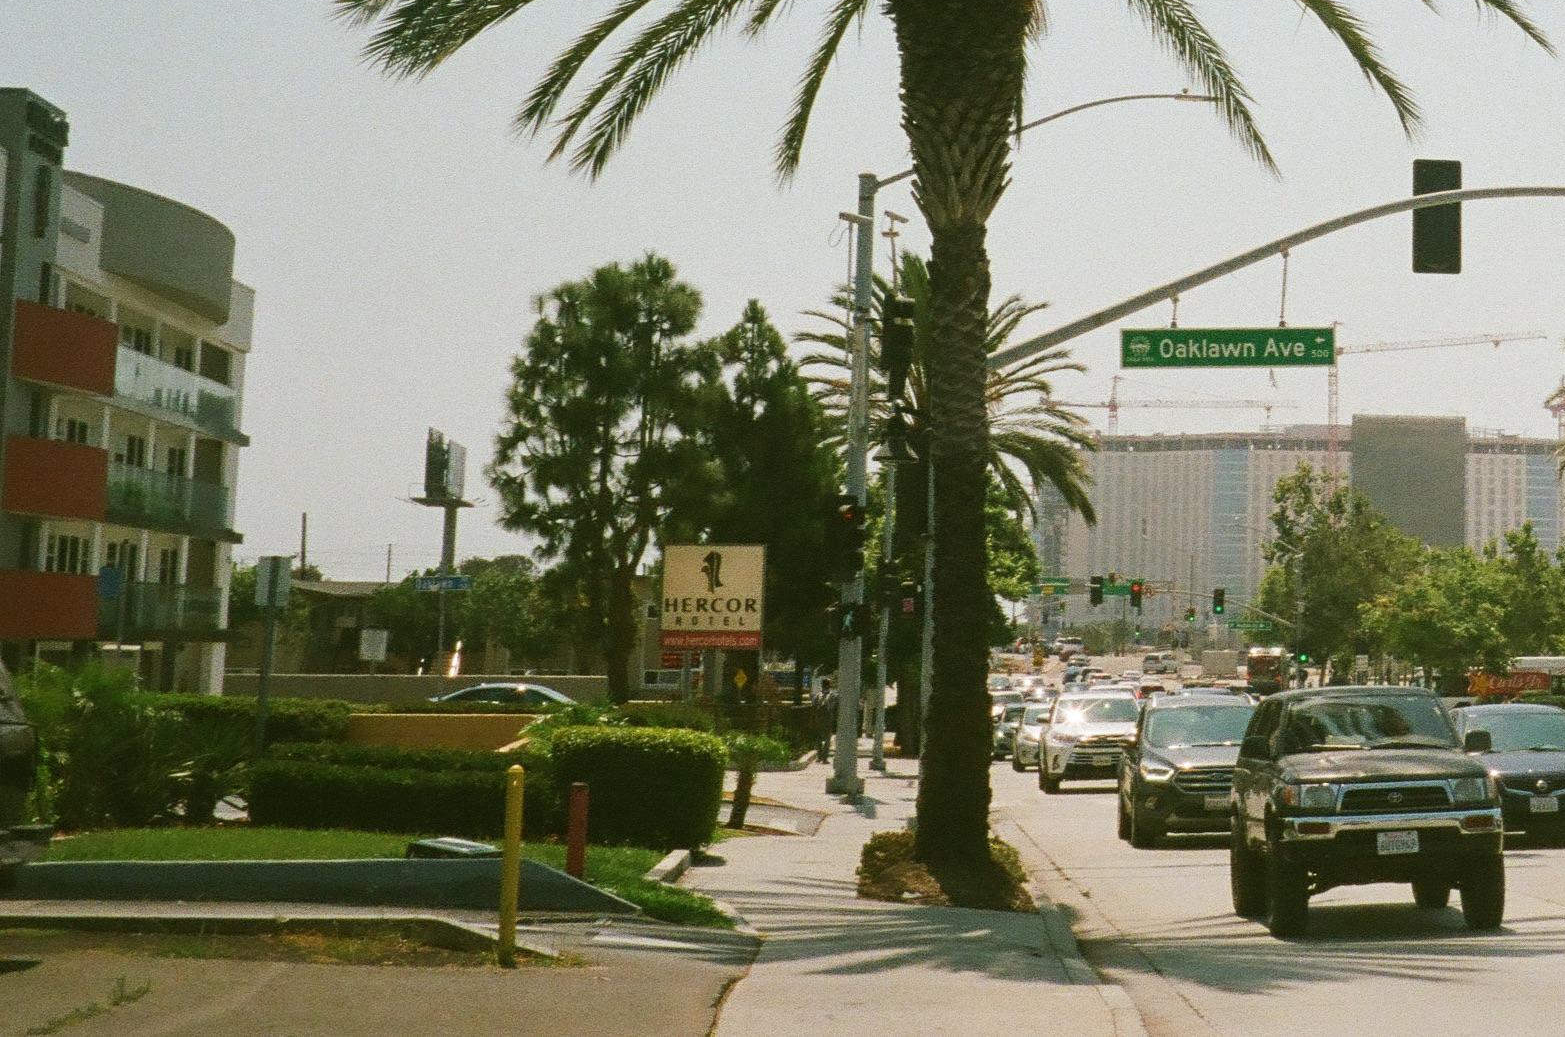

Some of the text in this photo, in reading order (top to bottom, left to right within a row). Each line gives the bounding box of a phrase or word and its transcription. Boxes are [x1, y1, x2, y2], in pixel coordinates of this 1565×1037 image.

[1159, 338, 1257, 358] Oaklawn
[1263, 337, 1306, 358] Ave
[664, 597, 758, 613] HERCOR
[675, 616, 745, 627] HOTEL
